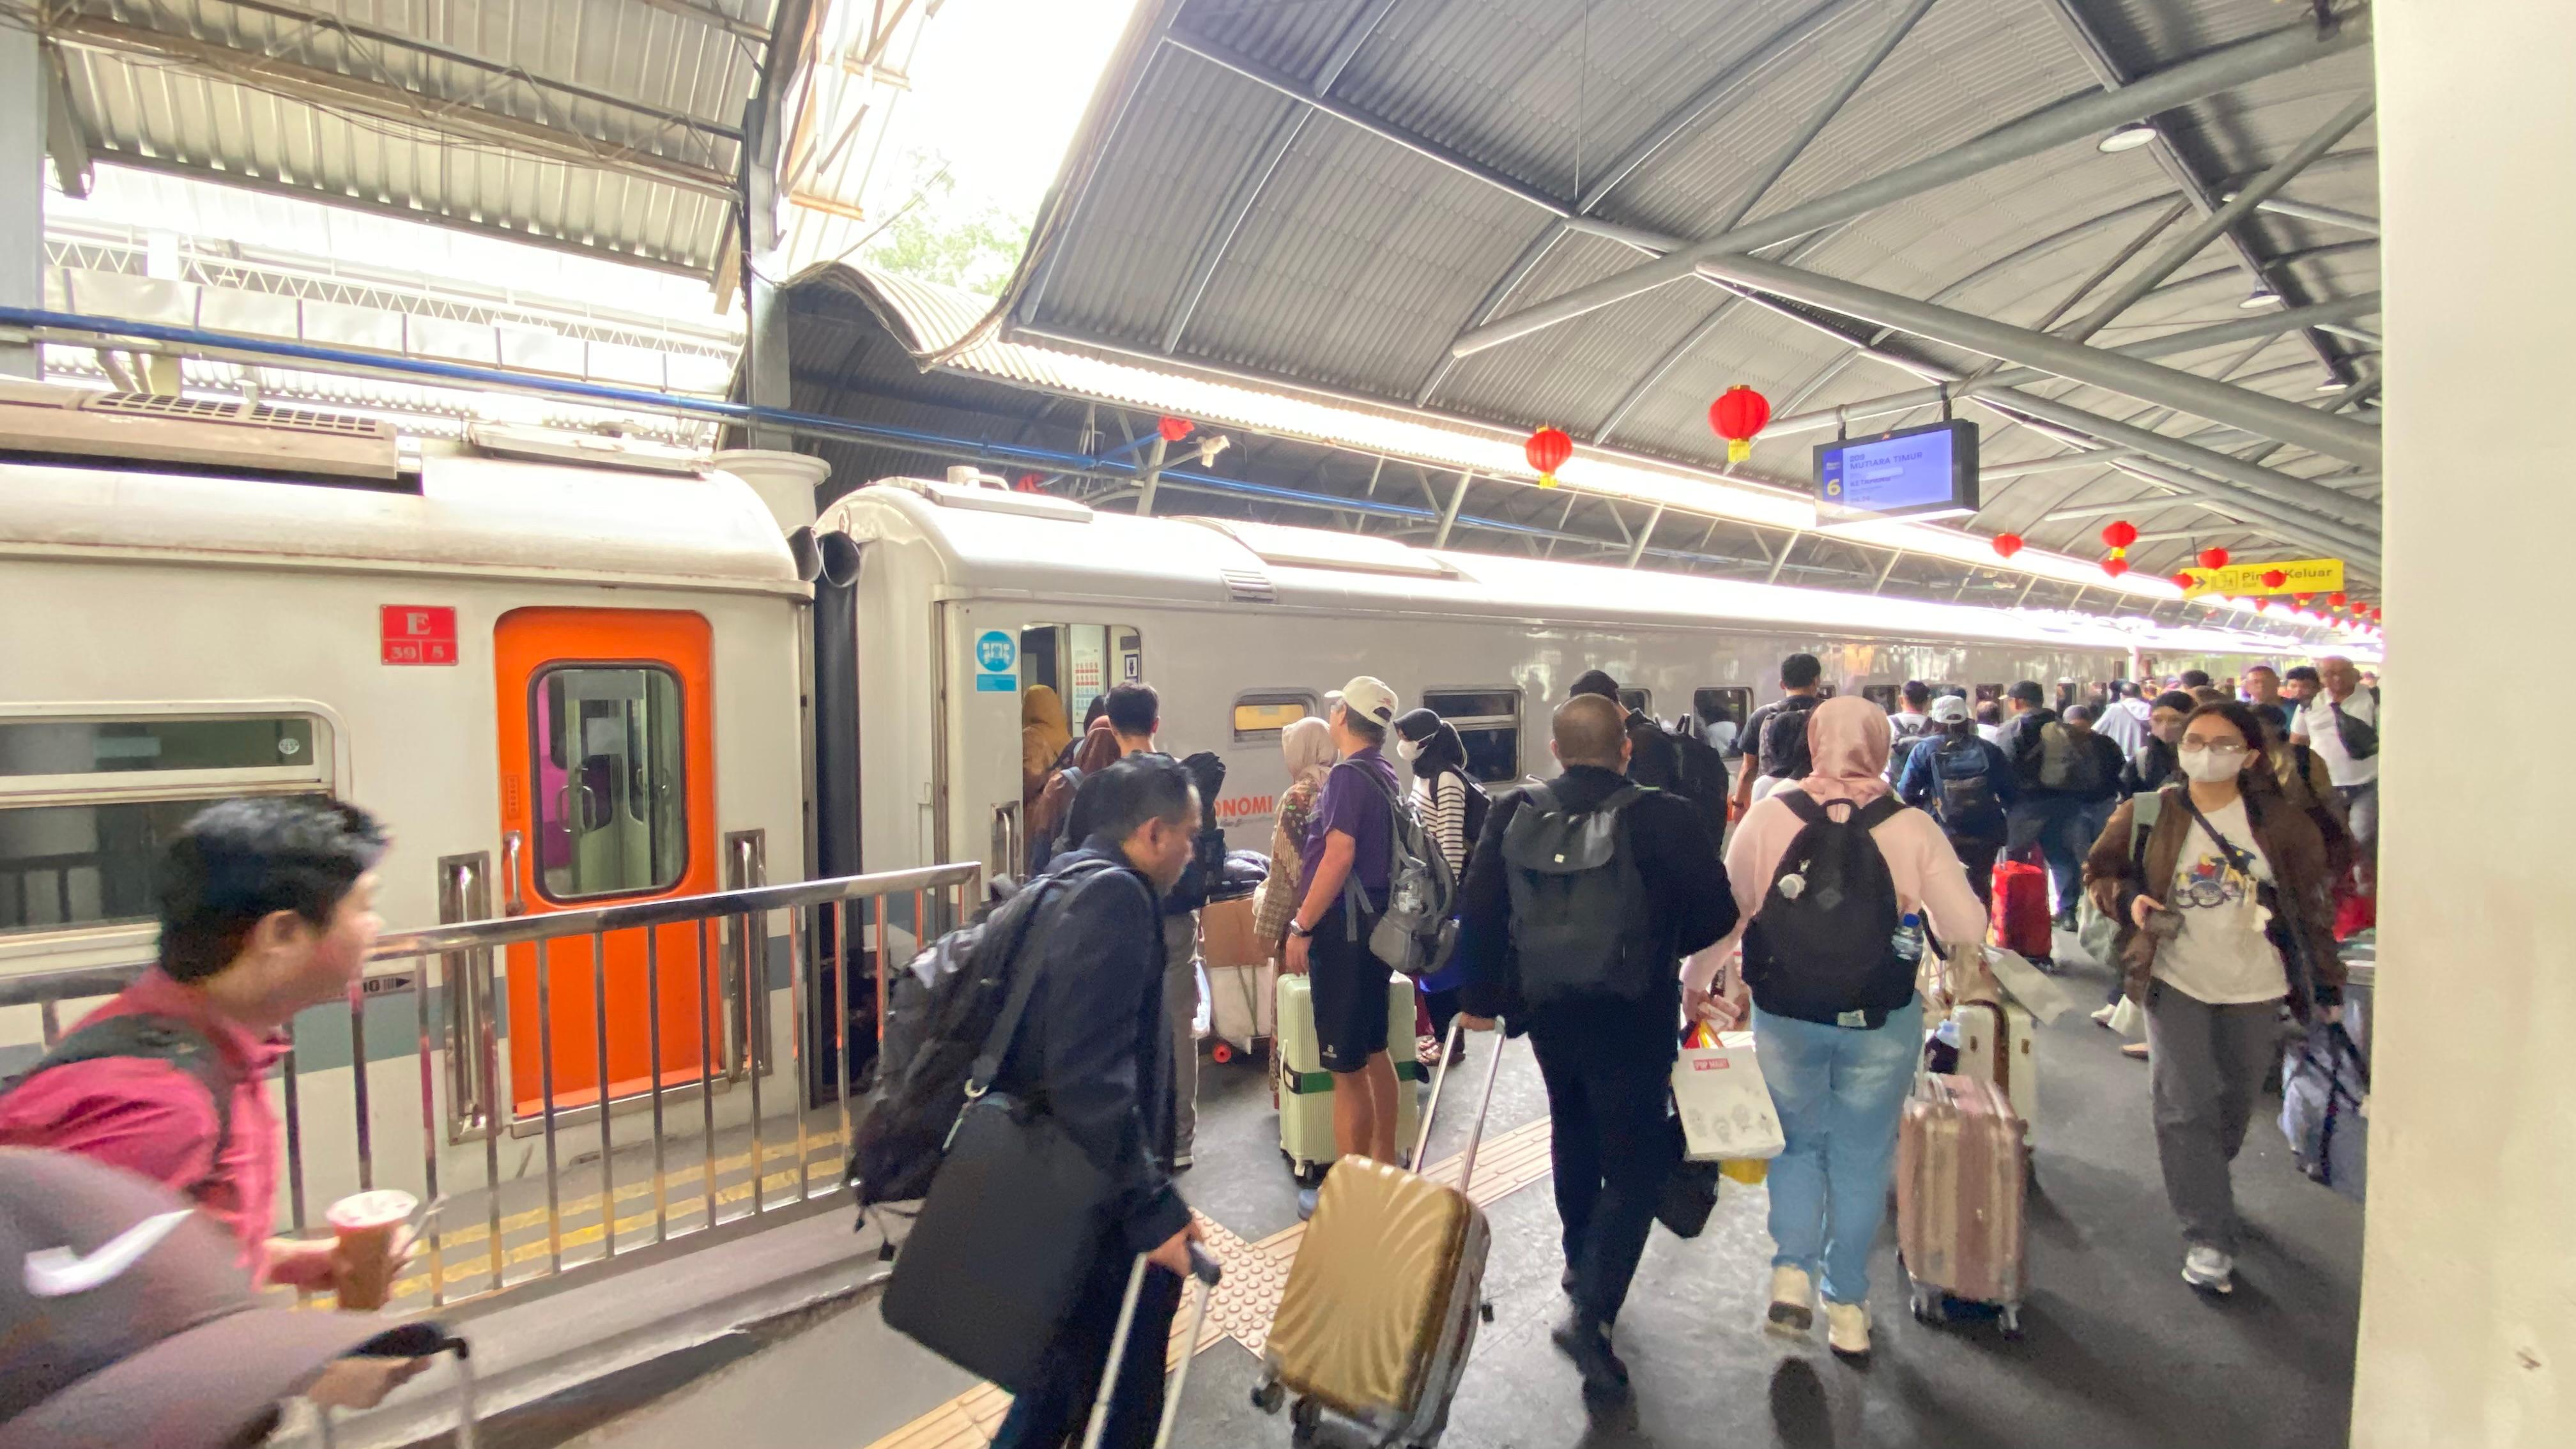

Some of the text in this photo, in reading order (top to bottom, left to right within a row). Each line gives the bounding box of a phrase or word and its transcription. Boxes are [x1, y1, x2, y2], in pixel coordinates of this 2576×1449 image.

[1850, 457, 1890, 470] MUTIARA
[1894, 452, 1922, 463] TIMUR
[1827, 479, 1841, 496] 6
[2285, 569, 2332, 578] Keluar
[406, 613, 431, 634] E
[432, 645, 444, 658] 5
